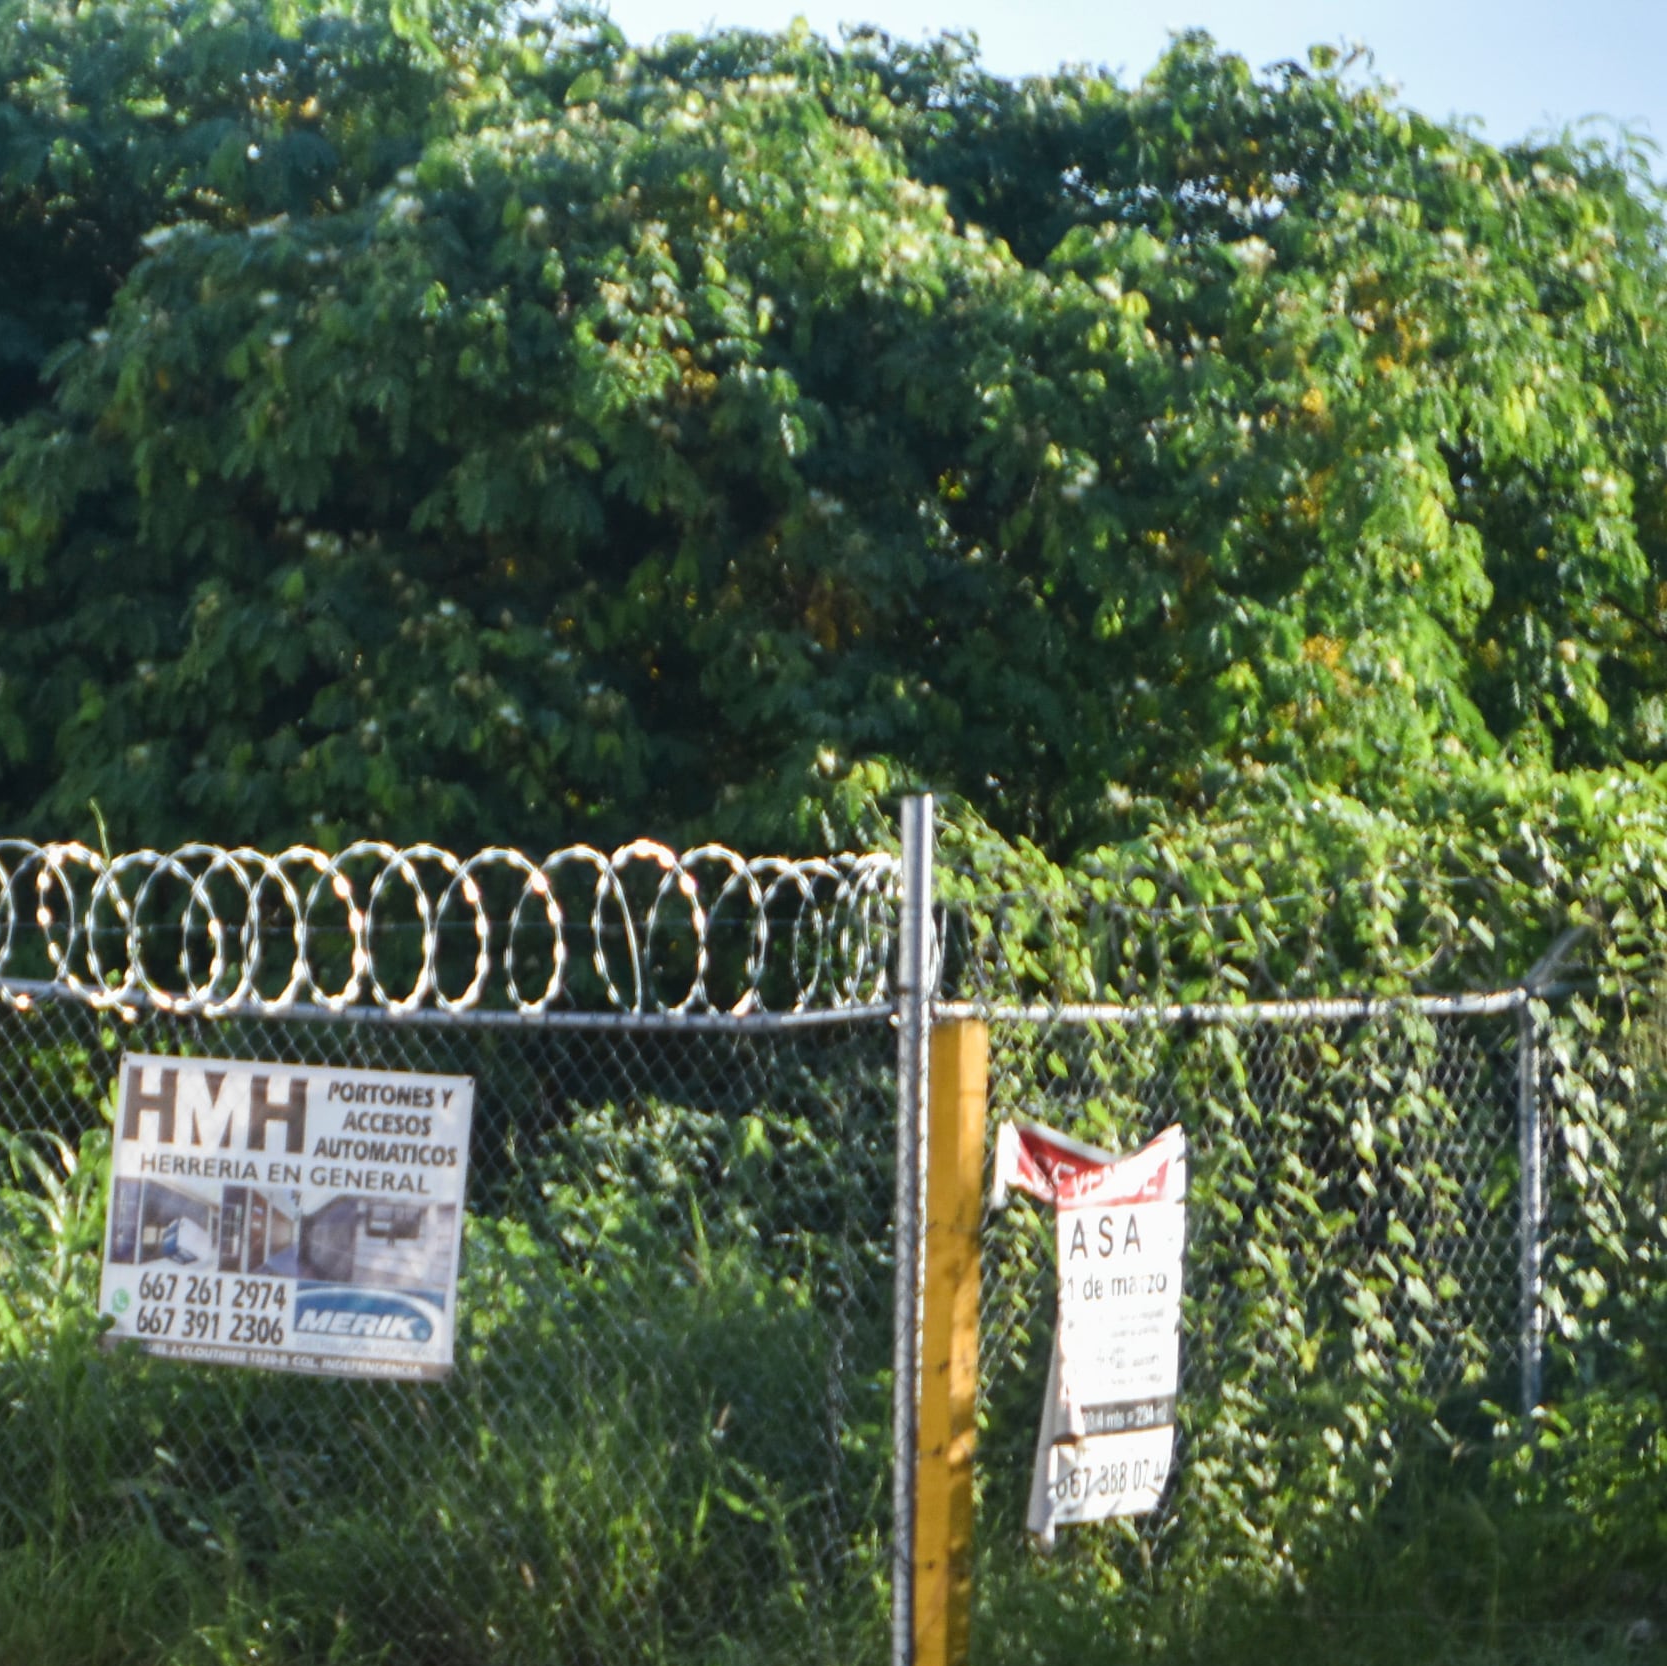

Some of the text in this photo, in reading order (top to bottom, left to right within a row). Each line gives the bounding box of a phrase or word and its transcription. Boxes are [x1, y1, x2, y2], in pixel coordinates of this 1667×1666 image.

[122, 1066, 308, 1154] HMH
[328, 1080, 454, 1108] PORTONES Y
[342, 1109, 432, 1137] ACCESOS
[314, 1136, 458, 1167] AUTOMATICOS
[140, 1152, 431, 1195] HERRERIA EN GENERAL
[139, 1271, 287, 1312] 667 261 2974
[1083, 1273, 1104, 1301] de
[1111, 1272, 1168, 1297] mazo
[137, 1305, 284, 1345] 667 391 2306
[297, 1308, 417, 1341] MERIK
